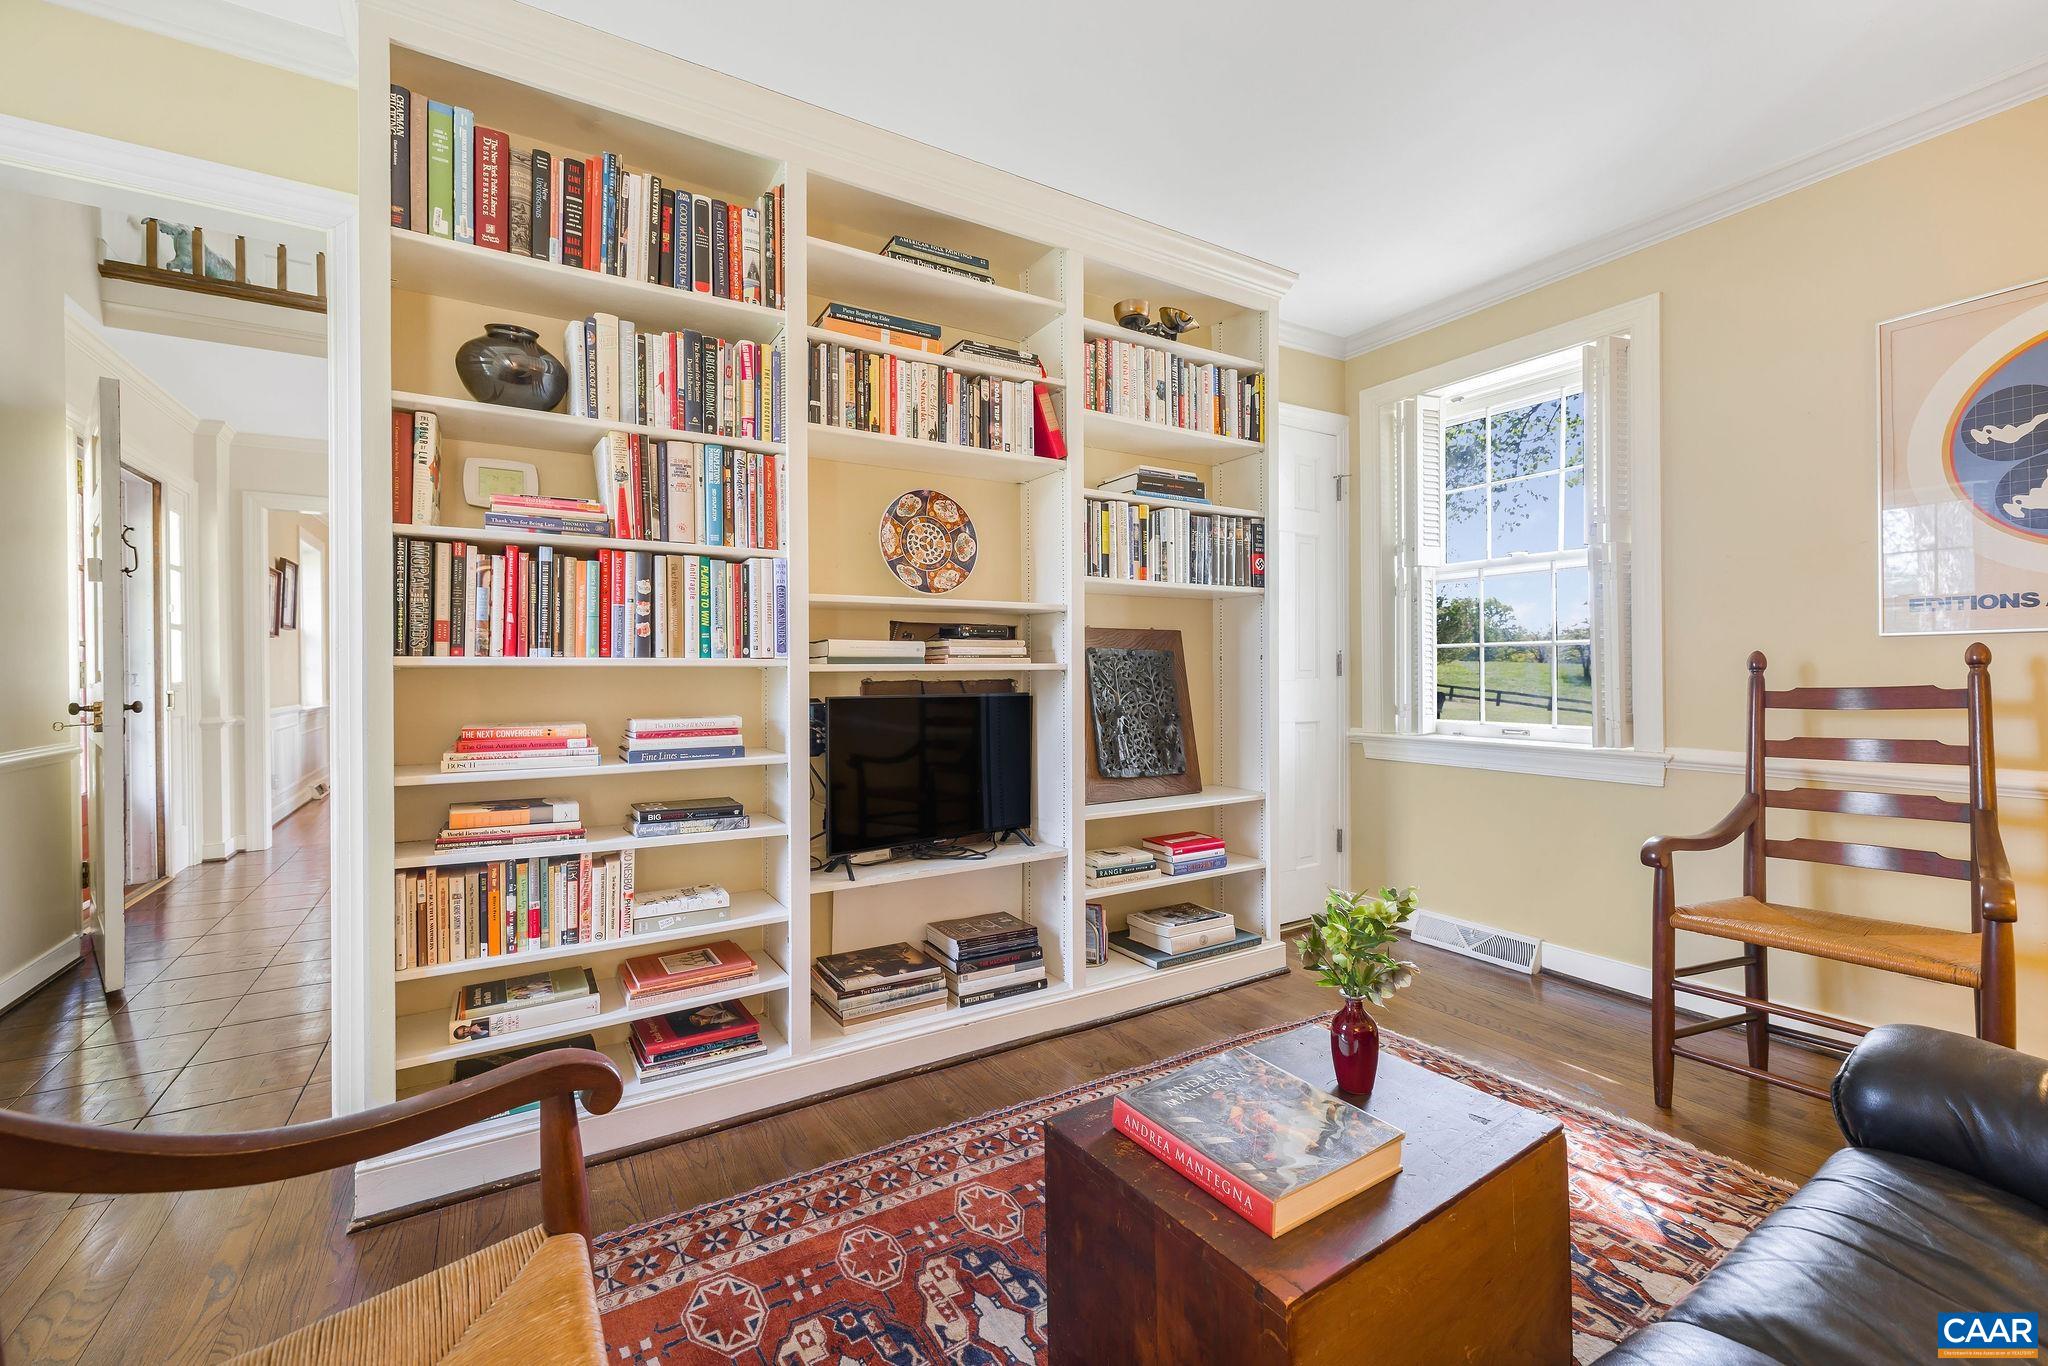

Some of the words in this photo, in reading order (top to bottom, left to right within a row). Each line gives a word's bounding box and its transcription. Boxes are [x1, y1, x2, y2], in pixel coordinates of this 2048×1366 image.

[396, 95, 404, 136] CHAPMAN
[482, 137, 491, 161] DESK
[482, 165, 491, 215] REFERENCE
[535, 177, 544, 218] Unconscious
[652, 179, 660, 224] CONNECTIONS
[490, 196, 498, 217] Library
[680, 204, 688, 224] GOOD
[680, 226, 688, 251] WORDS
[716, 221, 725, 252] GREAT
[900, 237, 929, 248] AMERICAN
[931, 244, 944, 252] FOLK
[945, 248, 973, 259] PAINTINGS
[680, 252, 688, 262] TO
[679, 263, 688, 277] YOU
[706, 351, 715, 372] FABLES
[706, 381, 714, 418] ABUNDANCE
[419, 422, 429, 444] COLOR
[418, 451, 427, 465] LAW
[737, 458, 745, 500] Abundance
[411, 545, 430, 593] MORAL
[701, 565, 709, 595] PLAYING
[701, 598, 709, 608] TO
[410, 602, 429, 648] MINDS
[701, 610, 709, 626] WIN
[778, 613, 786, 645] SAUNDERS
[462, 731, 475, 739] THE
[476, 730, 494, 738] NEXT
[641, 753, 658, 761] Fine
[659, 752, 678, 760] Lines
[624, 850, 631, 861] JO
[623, 863, 632, 890] NESBØ
[1100, 868, 1122, 877] RANGE
[871, 985, 892, 993] PORTRAIT
[1165, 1072, 1250, 1108] MANTEGNA
[1166, 1069, 1228, 1096] ANDREA
[1124, 1115, 1170, 1153] ANDREA
[1175, 1151, 1253, 1210] MANTEGNA
